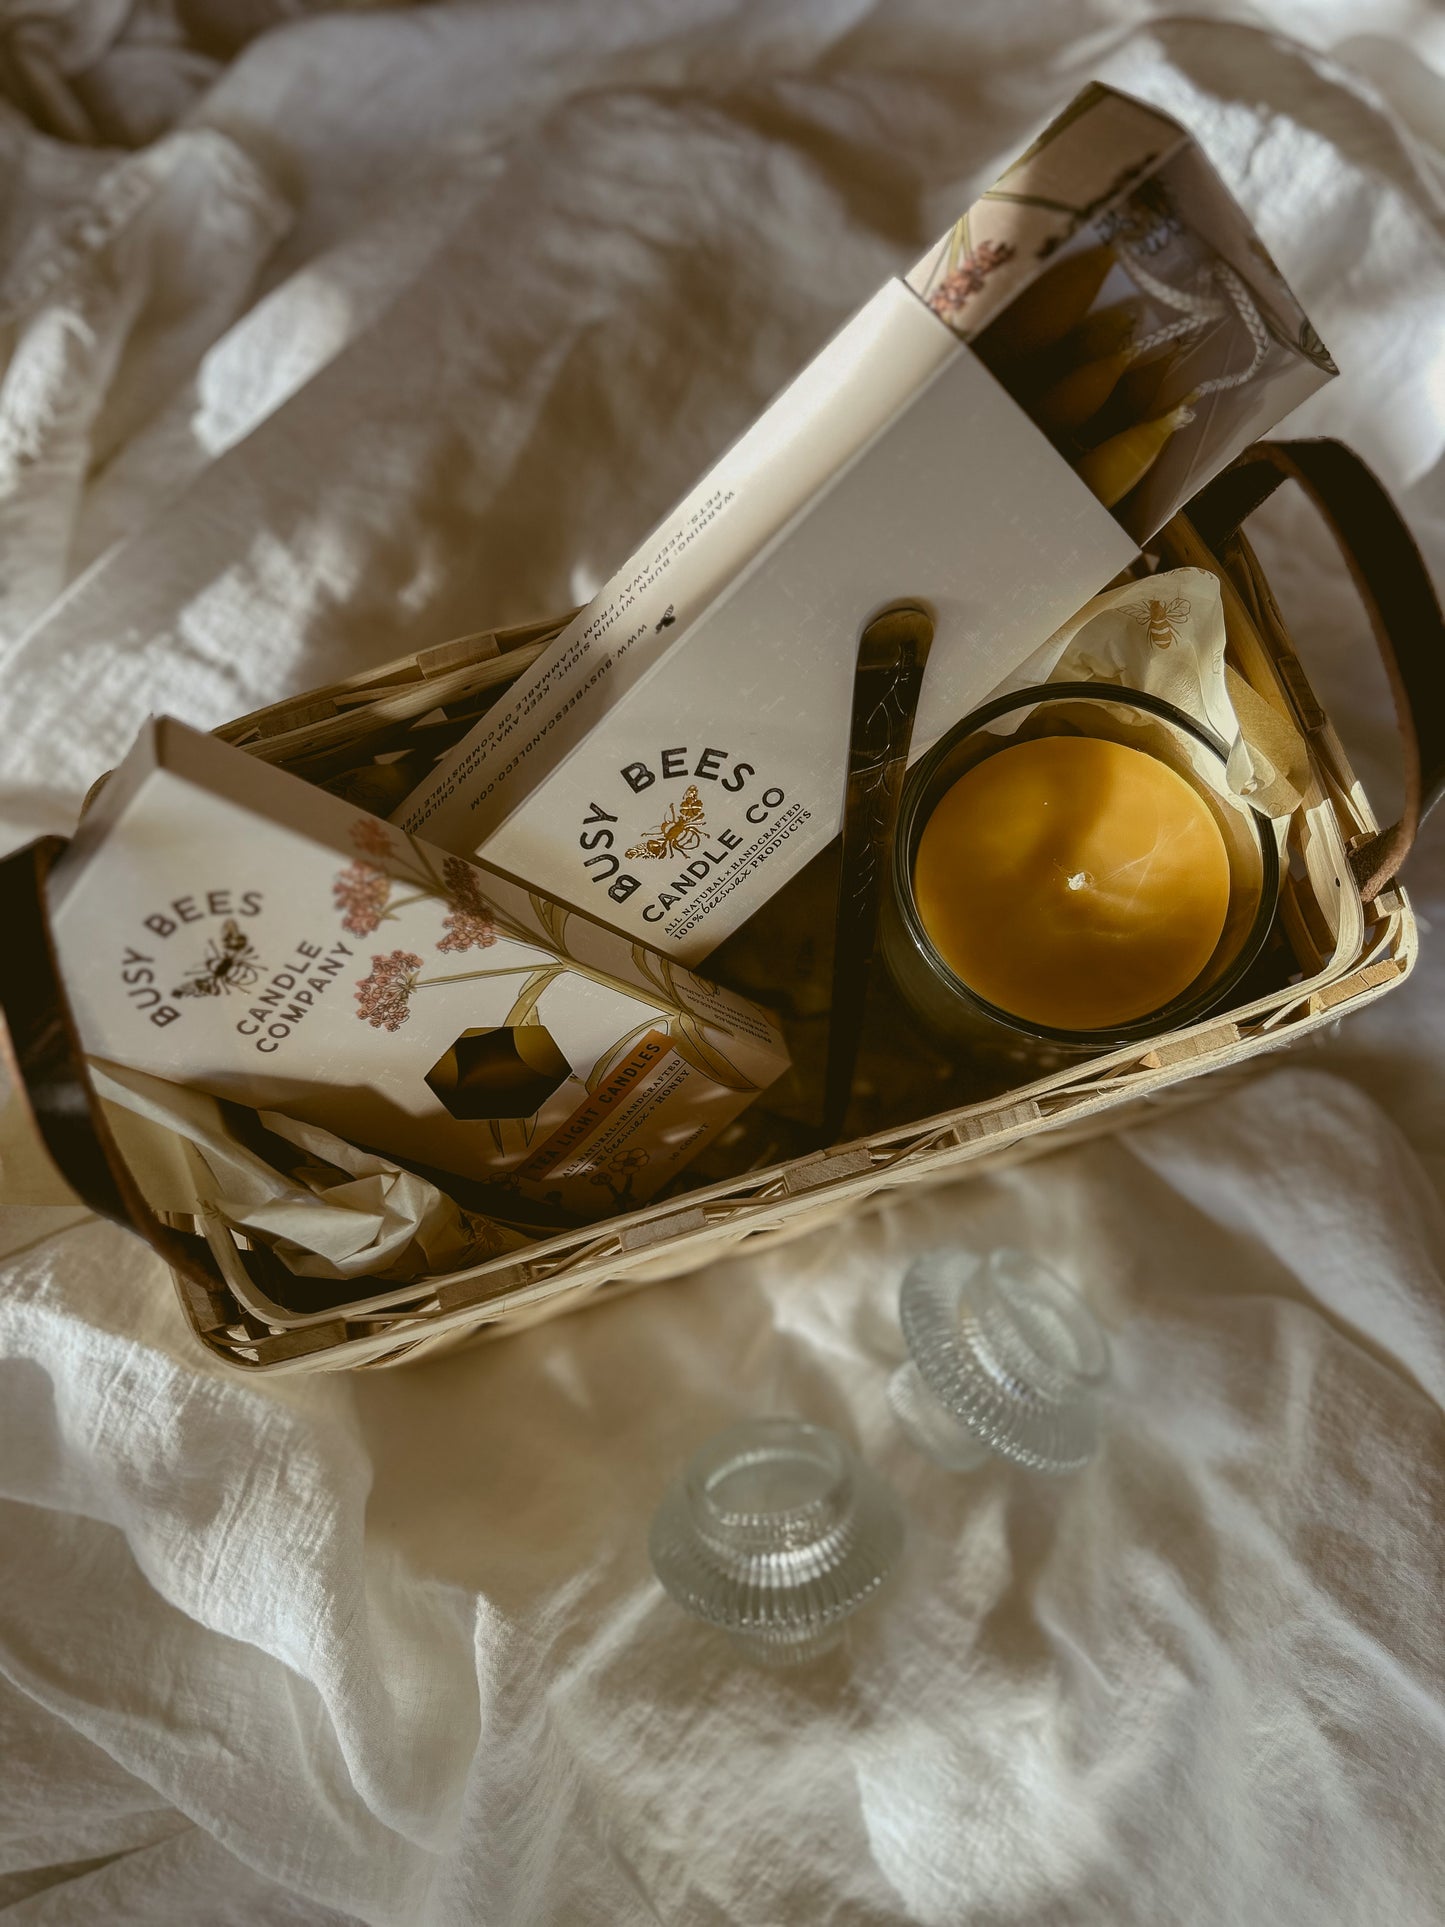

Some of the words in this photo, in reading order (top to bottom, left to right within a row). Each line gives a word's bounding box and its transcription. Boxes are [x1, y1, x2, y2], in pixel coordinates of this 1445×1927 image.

[619, 565, 650, 602] AWAY
[639, 558, 670, 592] BURN
[654, 530, 684, 564] KEEP
[583, 603, 615, 639] FROM
[594, 595, 635, 641] WITHIN
[515, 640, 580, 713] FLAMMABLE
[524, 684, 550, 716] KEEP
[470, 623, 648, 811] WWW.BUSYBEESCANDLECO.COM
[490, 716, 520, 752] AWAY
[498, 713, 513, 730] OR
[424, 731, 495, 809] COMBUSTIBLE
[458, 751, 487, 784] FROM
[580, 802, 642, 904] BUSY
[620, 747, 755, 794] BEES
[642, 828, 744, 922] CANDLE
[745, 787, 785, 824] CO
[664, 917, 683, 934] ALL
[682, 875, 726, 916] NATURAL
[731, 803, 801, 871] HANDCRAFTED
[674, 913, 704, 941] 100%
[701, 869, 752, 914] beeswax
[750, 810, 812, 869] PRODUCTS
[143, 890, 263, 939] BEES
[122, 947, 182, 1028] BUSY
[236, 940, 323, 1035] CANDLE
[255, 941, 354, 1053] COMPANY
[530, 1149, 560, 1171] TEA
[558, 1108, 599, 1147] LIGHT
[598, 1043, 661, 1104] CANDLES
[562, 1163, 580, 1178] ALL
[578, 1126, 617, 1163] NATURAL
[620, 1059, 681, 1121] HANDCRAFTED
[603, 1113, 650, 1154] beeswax
[655, 1069, 690, 1105] HONEY
[679, 1122, 710, 1151] COUNT
